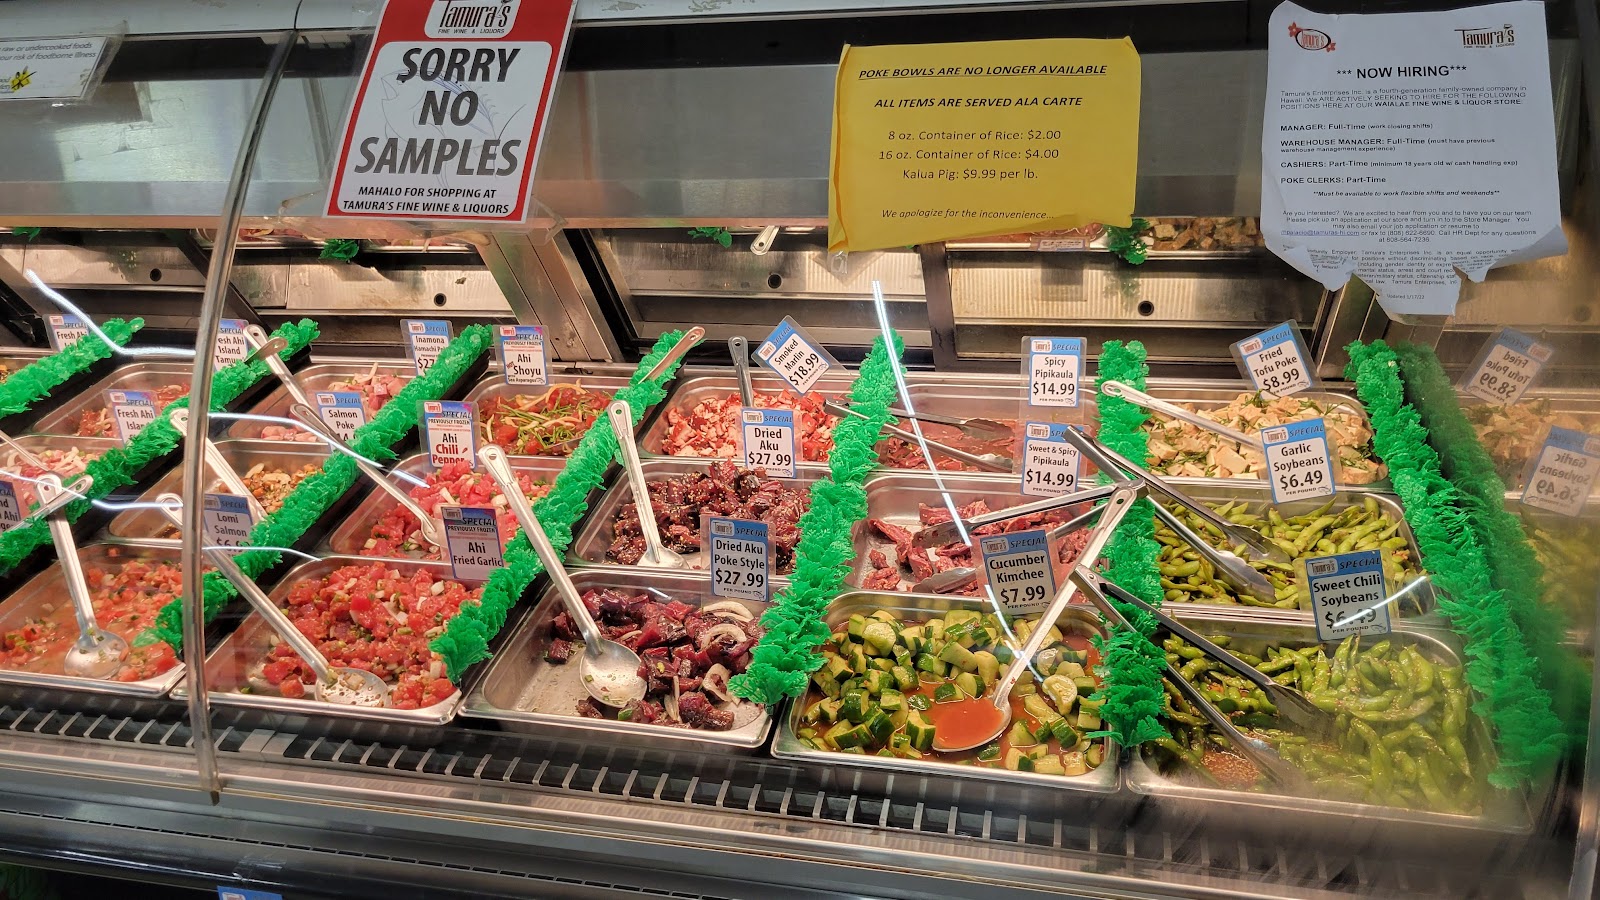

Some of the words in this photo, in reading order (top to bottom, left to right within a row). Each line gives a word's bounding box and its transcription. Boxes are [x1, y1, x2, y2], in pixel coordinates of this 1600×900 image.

[438, 0, 511, 27] Tamura's
[1454, 24, 1515, 46] Tamura's
[25, 43, 72, 51] undercooked
[36, 52, 72, 60] foodborne
[396, 48, 521, 82] SORRY
[858, 69, 890, 79] POKE
[892, 68, 935, 77] BOWLS
[936, 67, 962, 76] ARE
[964, 66, 984, 76] NO
[986, 66, 1036, 75] LONGER
[1038, 65, 1108, 74] AVAILABLE
[1357, 66, 1393, 78] NOW
[418, 90, 478, 126] NO
[874, 98, 896, 108] ALL
[898, 98, 935, 108] ITEMS
[937, 98, 962, 108] ARE
[964, 98, 1012, 108] SERVED
[1014, 97, 1039, 106] ALA
[1042, 97, 1083, 106] CARTE
[888, 131, 895, 141] 8
[898, 132, 915, 141] oz.
[918, 130, 976, 141] Container
[979, 130, 992, 140] of
[996, 130, 1024, 140] Rice:
[1027, 129, 1062, 142] $2.00
[1280, 139, 1336, 147] WAREHOUSE
[354, 137, 522, 176] SAMPLES
[878, 150, 893, 160] 16
[896, 152, 912, 160] oz.
[916, 150, 974, 160] Container
[976, 150, 990, 160] of
[992, 150, 1022, 160] Rice:
[1024, 148, 1060, 160] $4.00
[902, 169, 934, 180] Kalua
[938, 169, 960, 182] Pig:
[962, 168, 996, 180] $9.99
[1000, 171, 1020, 182] per
[1023, 168, 1038, 180] lb.
[358, 186, 402, 196] MAHALO
[404, 188, 424, 197] FOR
[427, 188, 479, 198] SHOPPING
[480, 190, 496, 199] AT
[343, 200, 394, 210] TAMURA'S
[396, 202, 420, 212] FINE
[422, 202, 450, 212] WINE
[452, 204, 460, 213] &
[462, 204, 509, 214] LIQUORS
[882, 209, 898, 218] We
[899, 208, 944, 220] apologize
[943, 208, 959, 220] for
[961, 209, 978, 218] the
[979, 210, 1054, 220] inconvenience...
[416, 335, 444, 344] Inamona
[218, 346, 240, 354] Island
[774, 338, 798, 366] Smoked
[1258, 346, 1283, 362] Fried
[518, 354, 531, 362] Ahi
[784, 350, 805, 372] Marlin
[1044, 356, 1066, 368] Spicy
[514, 366, 542, 378] Shoyu
[788, 353, 820, 386] $18.99
[1252, 364, 1274, 378] Tofu
[1274, 356, 1298, 370] Poke
[1035, 370, 1073, 380] Pipikaula
[1262, 368, 1300, 392] $8.99
[1033, 381, 1075, 396] $14.99
[118, 410, 139, 418] Fresh
[140, 410, 154, 419] Ahi
[328, 410, 358, 418] Salmon
[442, 410, 472, 418] SPECIAL
[336, 420, 354, 430] Poke
[1289, 425, 1324, 438] SPECIAL
[442, 433, 458, 443] Ahi
[754, 428, 782, 438] Dried
[436, 444, 458, 454] Chili
[760, 440, 779, 450] Aku
[1028, 444, 1050, 453] Sweet
[1058, 447, 1078, 458] Spicy
[1280, 443, 1312, 457] Garlic
[748, 451, 792, 466] $27.99
[1032, 456, 1070, 466] Pipikaula
[1273, 456, 1324, 472] Soybeans
[1026, 468, 1074, 487] $14.99
[1280, 470, 1323, 492] $6.49
[221, 500, 248, 509] SPECIAL
[4, 510, 18, 522] Ahi
[216, 512, 238, 524] Lomi
[462, 517, 497, 526] SPECIAL
[214, 524, 248, 537] Salmon
[736, 528, 767, 538] SPECIAL
[468, 542, 486, 554] Ahi
[716, 540, 742, 552] Dried
[744, 543, 763, 554] Aku
[454, 555, 476, 566] Fried
[476, 556, 502, 567] Garlic
[714, 554, 738, 566] Poke
[740, 557, 764, 570] Style
[990, 554, 1045, 570] Cucumber
[1340, 558, 1380, 570] SPECIAL
[715, 568, 764, 588] $27.99
[996, 570, 1044, 584] Kimchee
[1313, 579, 1351, 593] Sweet
[1354, 574, 1380, 587] Chili
[1000, 586, 1046, 606] $7.99
[1321, 592, 1379, 608] Soybeans
